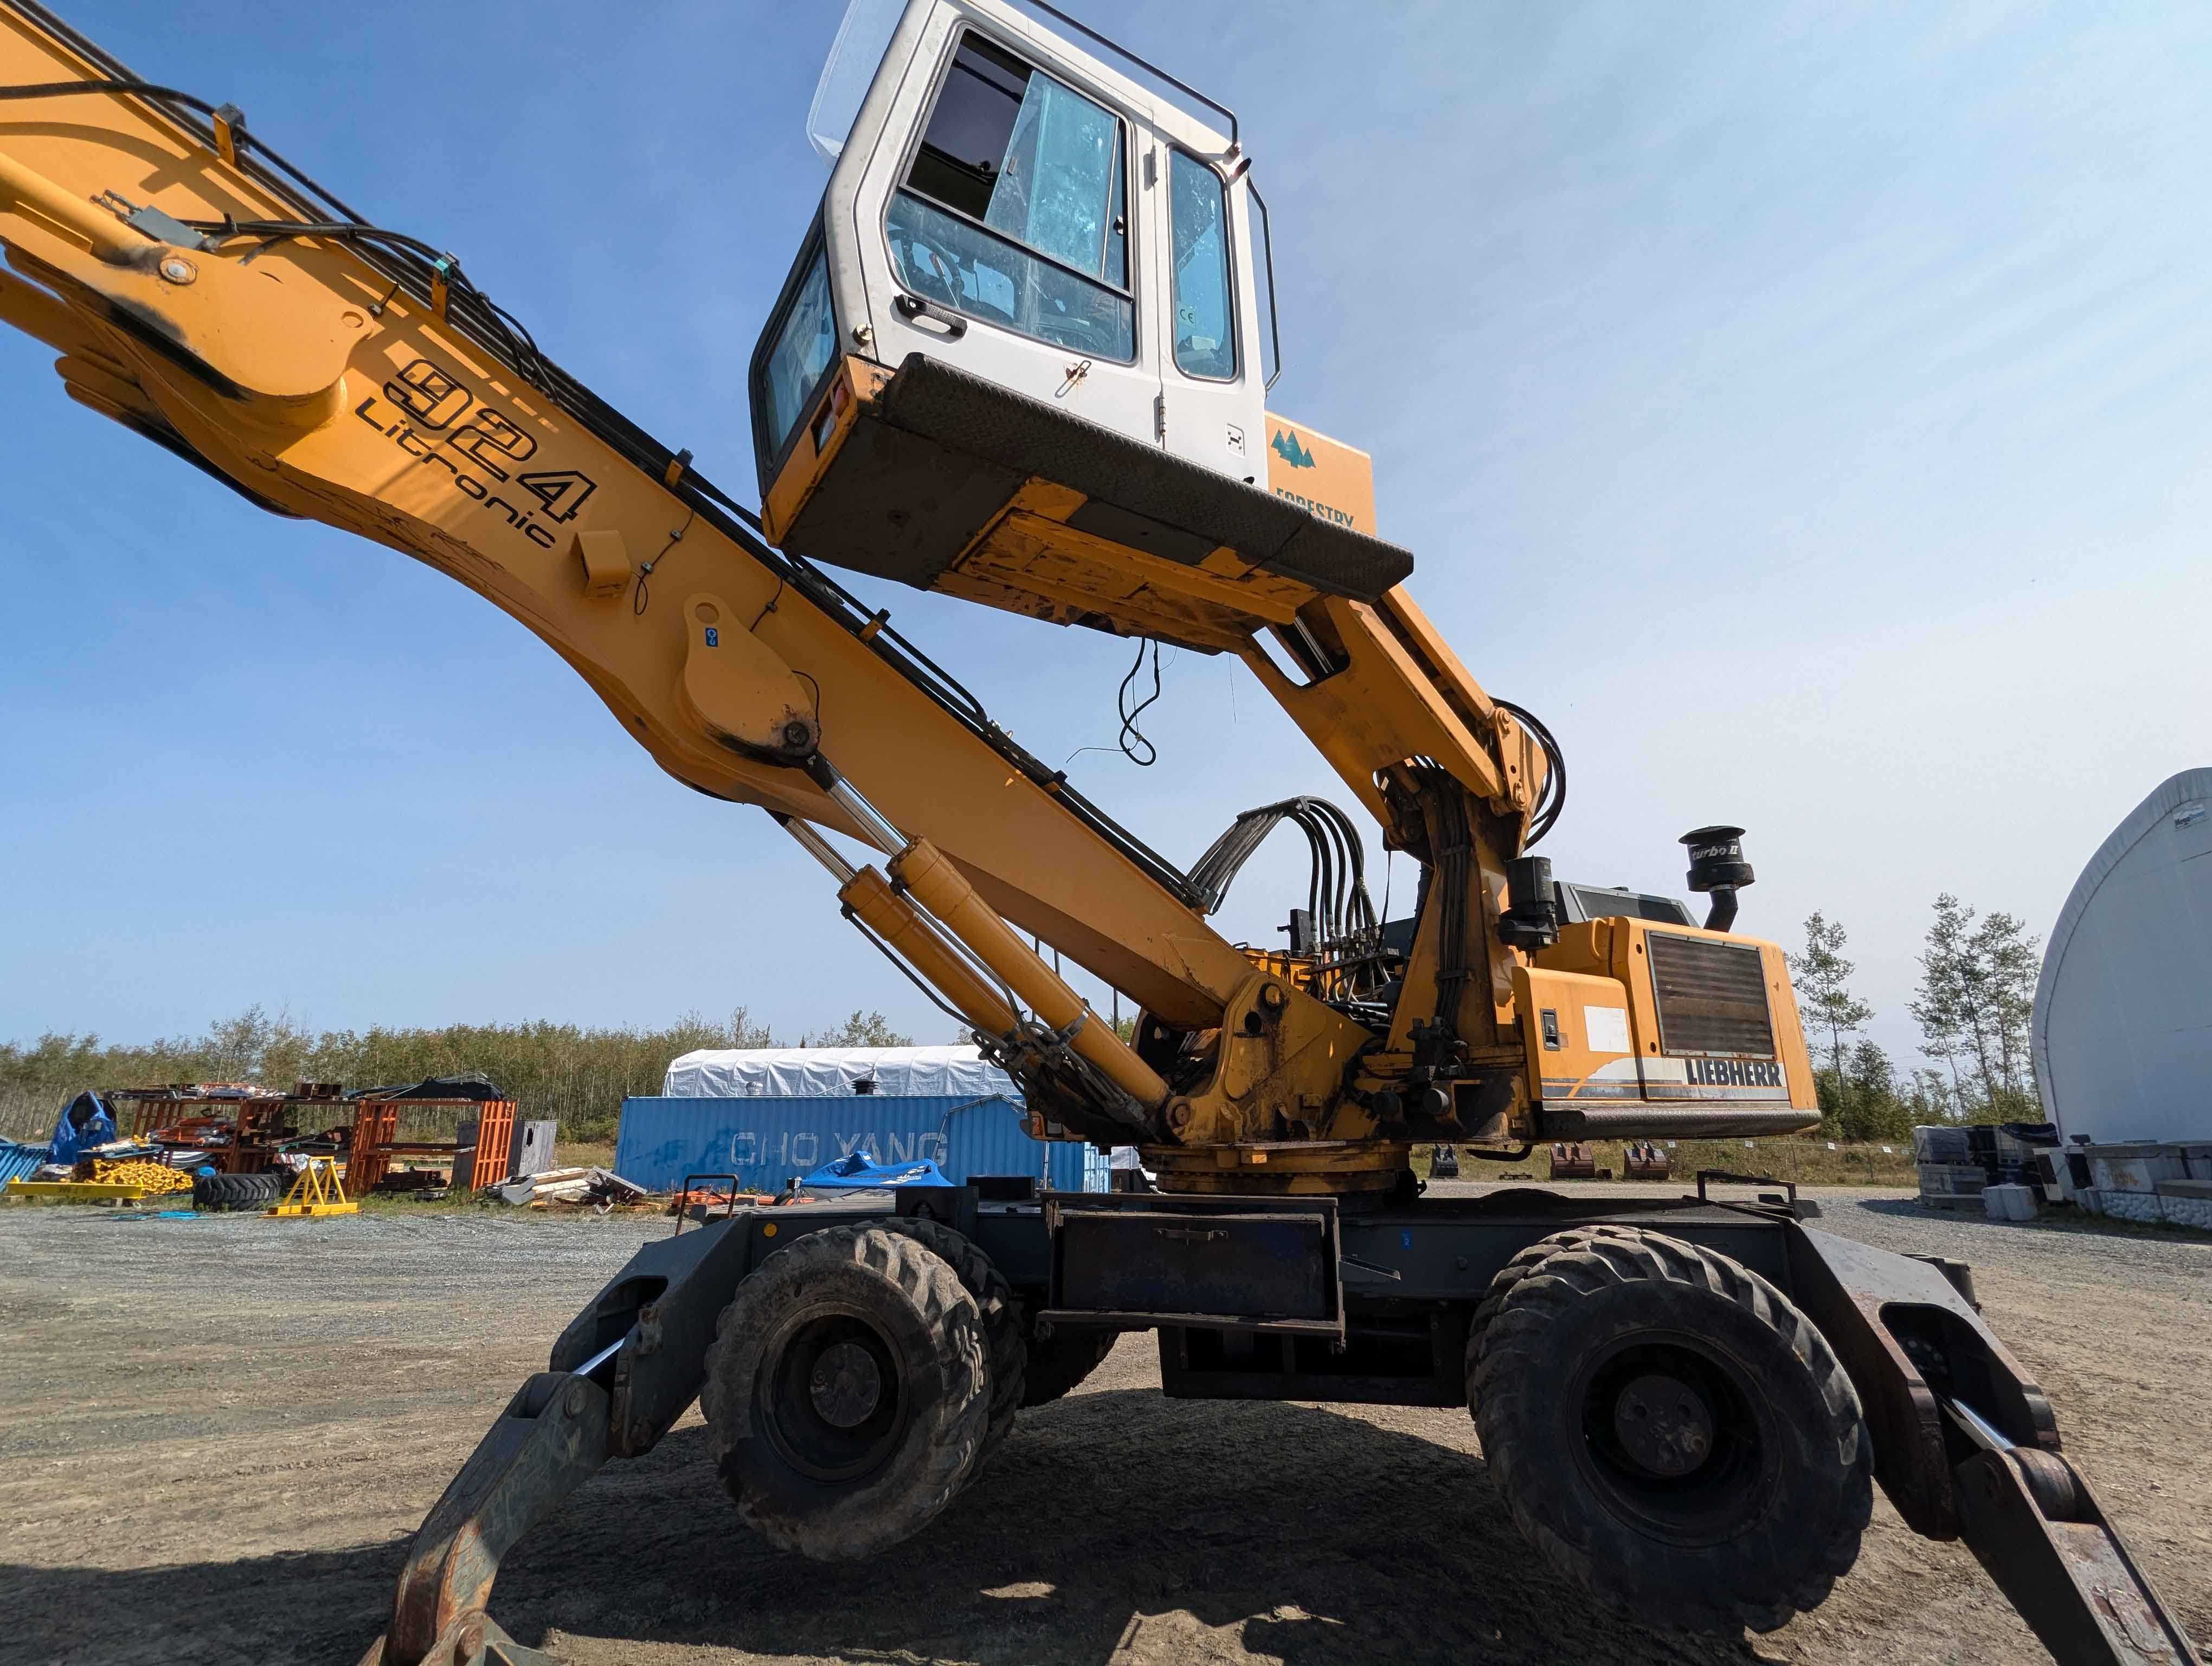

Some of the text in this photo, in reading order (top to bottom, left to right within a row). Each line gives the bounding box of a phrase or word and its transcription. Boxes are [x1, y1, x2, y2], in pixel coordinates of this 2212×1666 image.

[383, 359, 598, 524] 924
[355, 396, 556, 548] Litronic
[1692, 846, 1727, 860] turbo
[1684, 1059, 1783, 1087] LIEBHERR
[731, 1132, 948, 1167] CHO YANG
